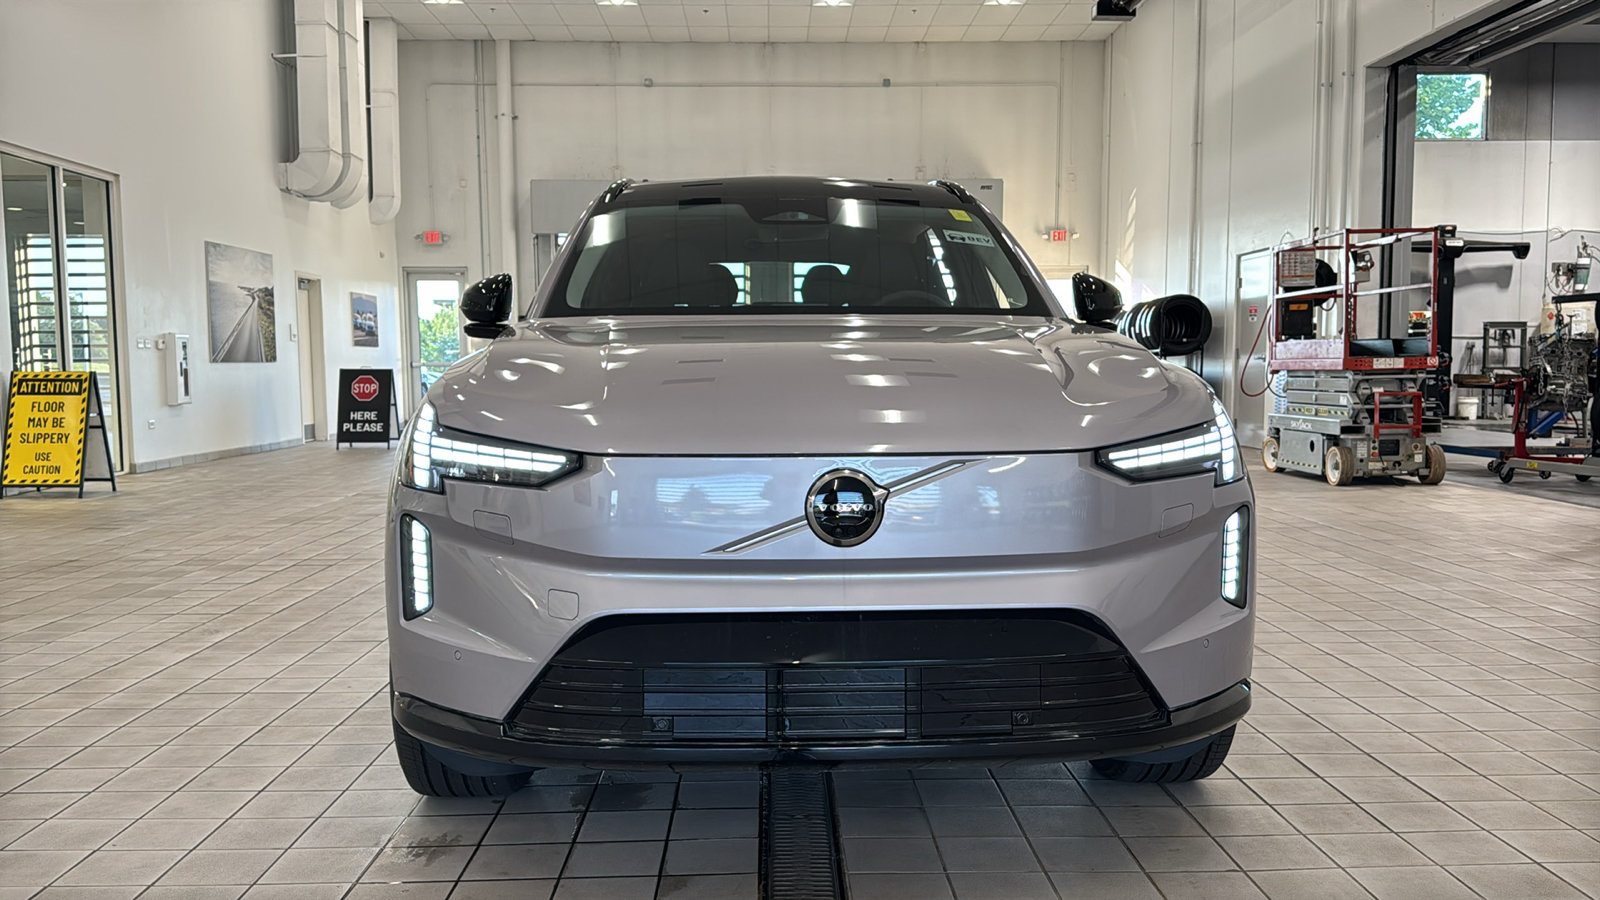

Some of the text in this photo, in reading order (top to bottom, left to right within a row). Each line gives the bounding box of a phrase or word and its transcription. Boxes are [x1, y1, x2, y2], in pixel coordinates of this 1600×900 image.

[424, 231, 440, 243] EXIT
[967, 236, 990, 244] BEV
[1052, 230, 1067, 241] EXIT
[20, 381, 80, 393] ATTENTION
[353, 383, 377, 393] STOP
[31, 401, 65, 413] FLOOR
[350, 411, 378, 420] HERE
[27, 417, 66, 428] MAY BE
[343, 422, 384, 432] PLEASE
[19, 432, 71, 444] SLIPPERY
[34, 451, 52, 462] USE
[23, 464, 61, 475] CAUTION
